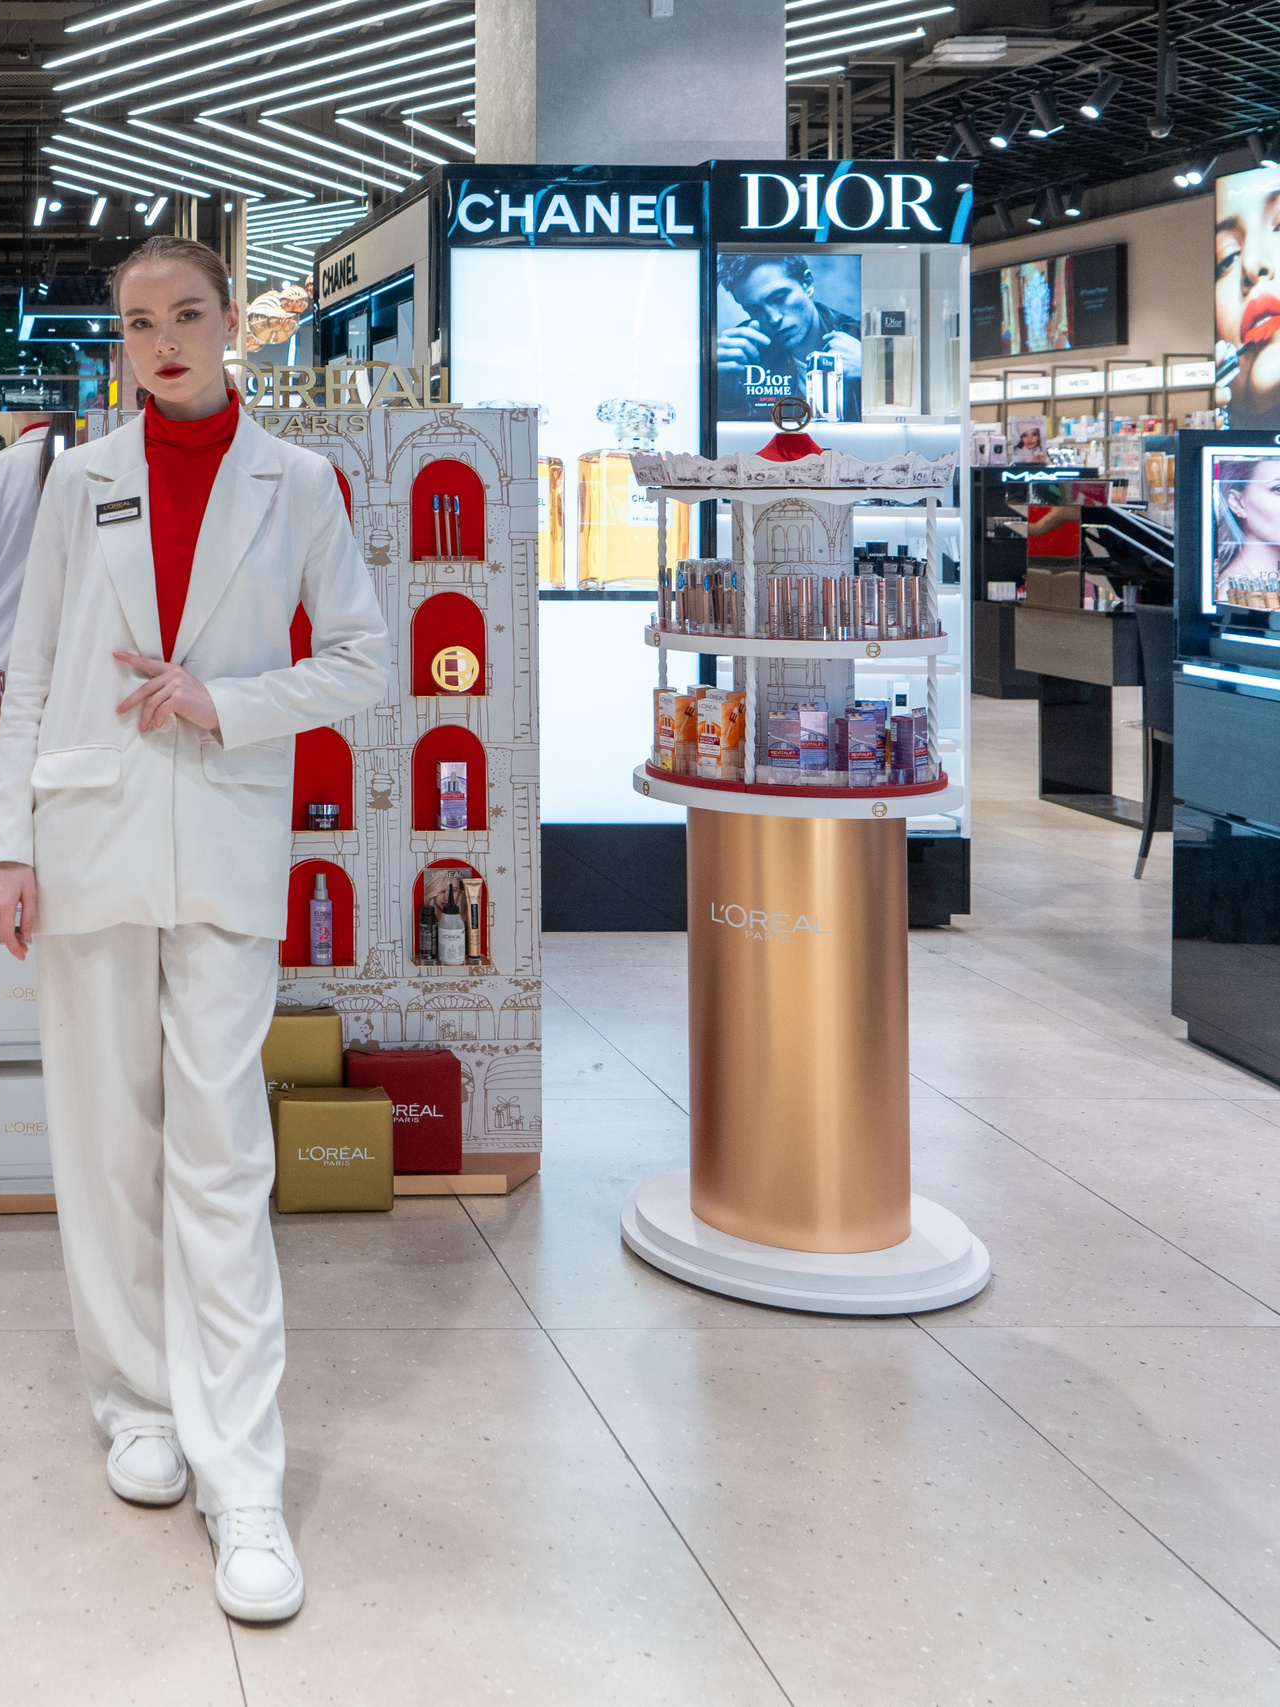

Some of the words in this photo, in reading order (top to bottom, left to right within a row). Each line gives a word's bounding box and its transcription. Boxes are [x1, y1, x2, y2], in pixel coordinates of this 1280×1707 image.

[739, 173, 943, 232] DIOR
[456, 193, 694, 236] CHANEL
[322, 252, 358, 299] CHANEL
[743, 364, 792, 386] Dior
[746, 386, 792, 396] HOMME
[262, 415, 367, 435] PARIS
[711, 902, 834, 936] L'ORÉAL
[745, 930, 790, 945] PARIS
[4, 987, 37, 998] L'OR
[298, 1145, 375, 1161] L'ORÉAL
